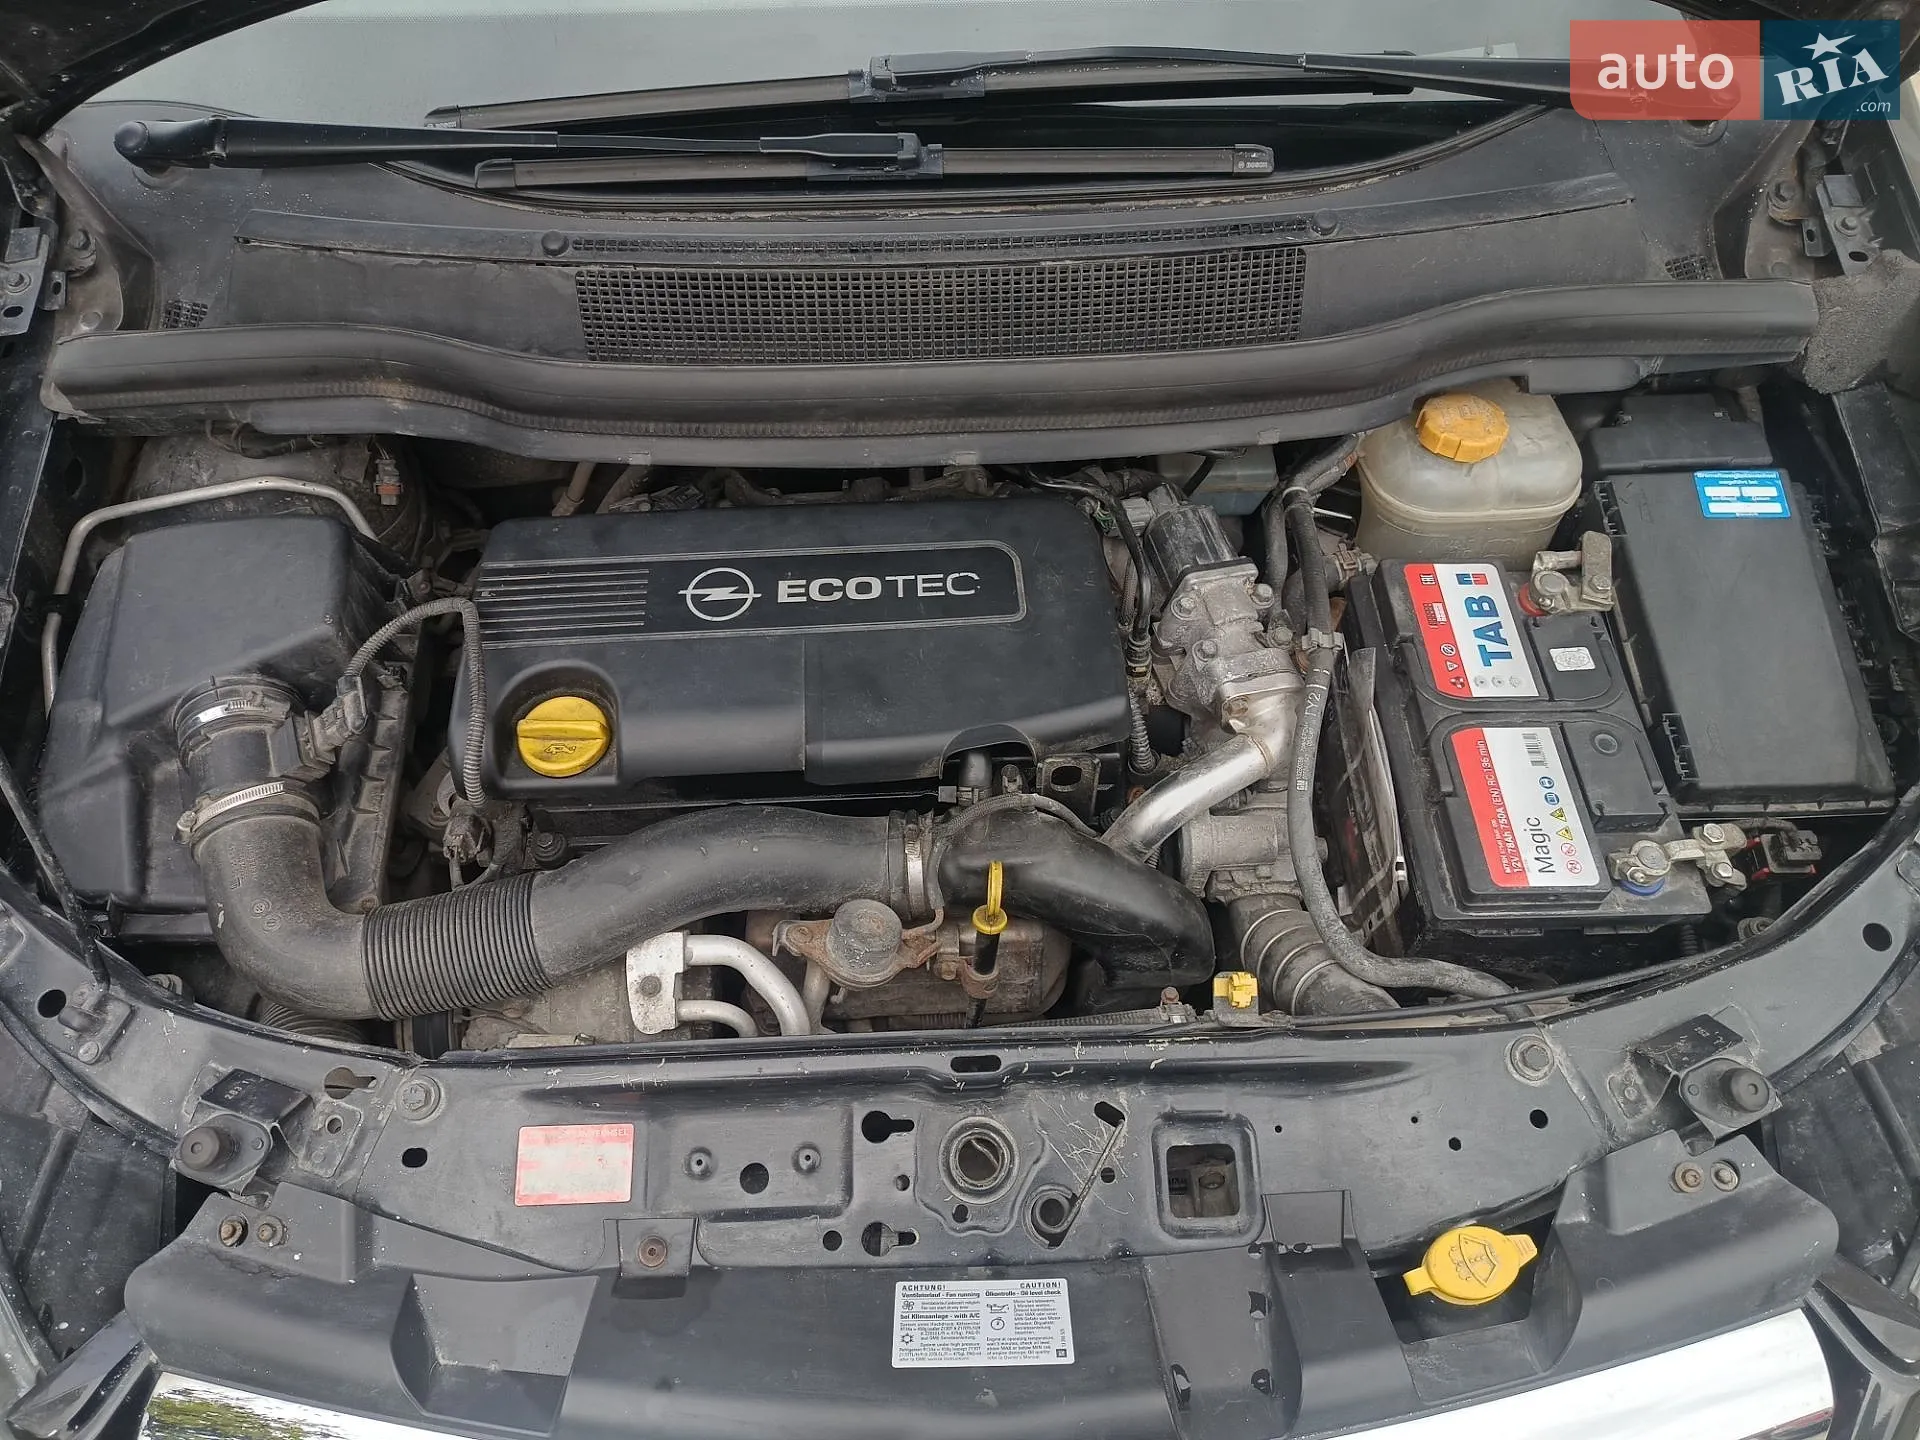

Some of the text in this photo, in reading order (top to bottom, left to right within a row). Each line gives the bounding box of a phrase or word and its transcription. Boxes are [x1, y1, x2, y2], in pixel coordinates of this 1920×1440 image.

[777, 572, 981, 604] ECOTEC
[1464, 594, 1513, 668] TAB
[1477, 740, 1490, 756] min
[1482, 756, 1494, 772] 136
[1486, 774, 1497, 785] RC
[1490, 787, 1504, 805] (EN)
[1496, 807, 1510, 829] 750A
[1503, 832, 1518, 854] 78Ah
[1524, 817, 1551, 873] Magic
[1510, 856, 1523, 873] 12V
